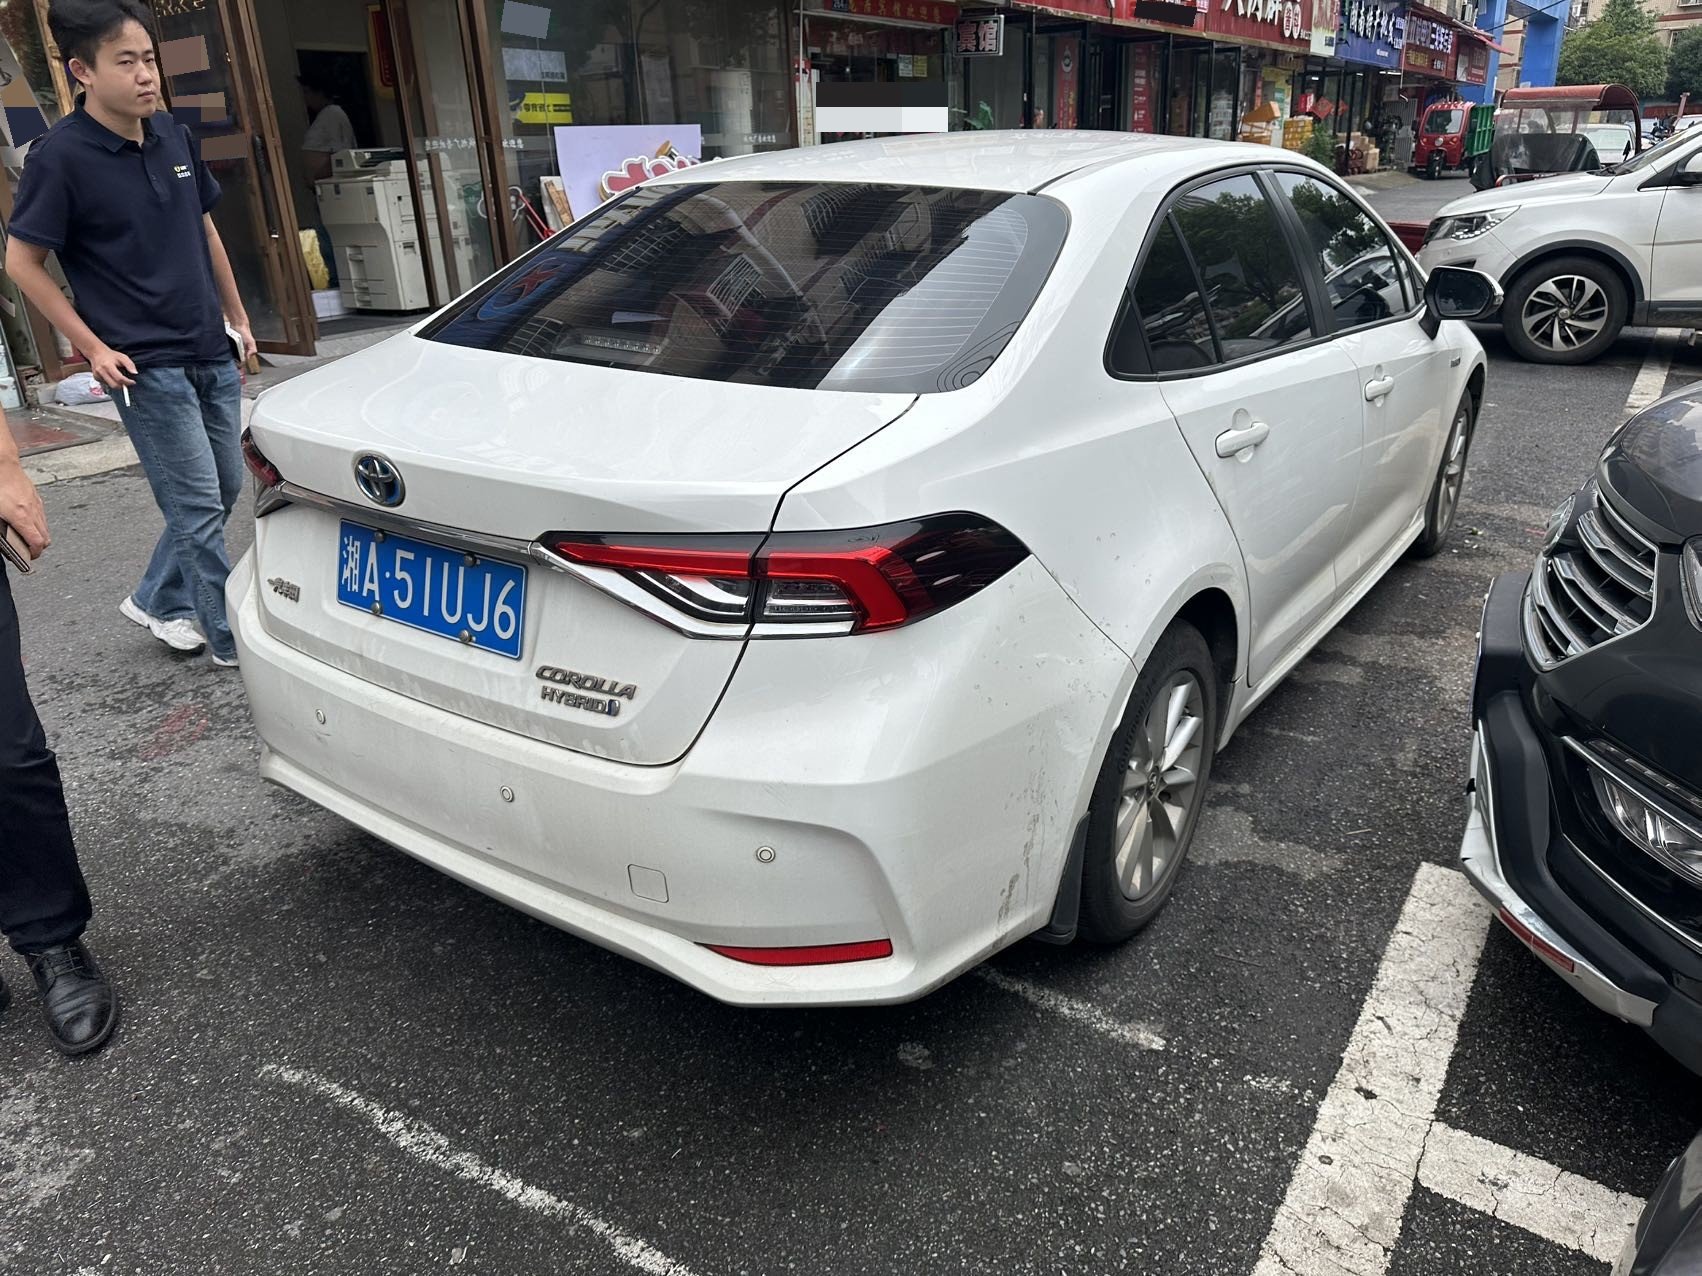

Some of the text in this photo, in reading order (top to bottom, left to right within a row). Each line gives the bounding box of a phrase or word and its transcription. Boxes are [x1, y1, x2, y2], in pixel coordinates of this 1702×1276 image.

[957, 20, 998, 52] 宾馆
[535, 665, 637, 700] COROLLA
[541, 685, 608, 715] HYBRID
